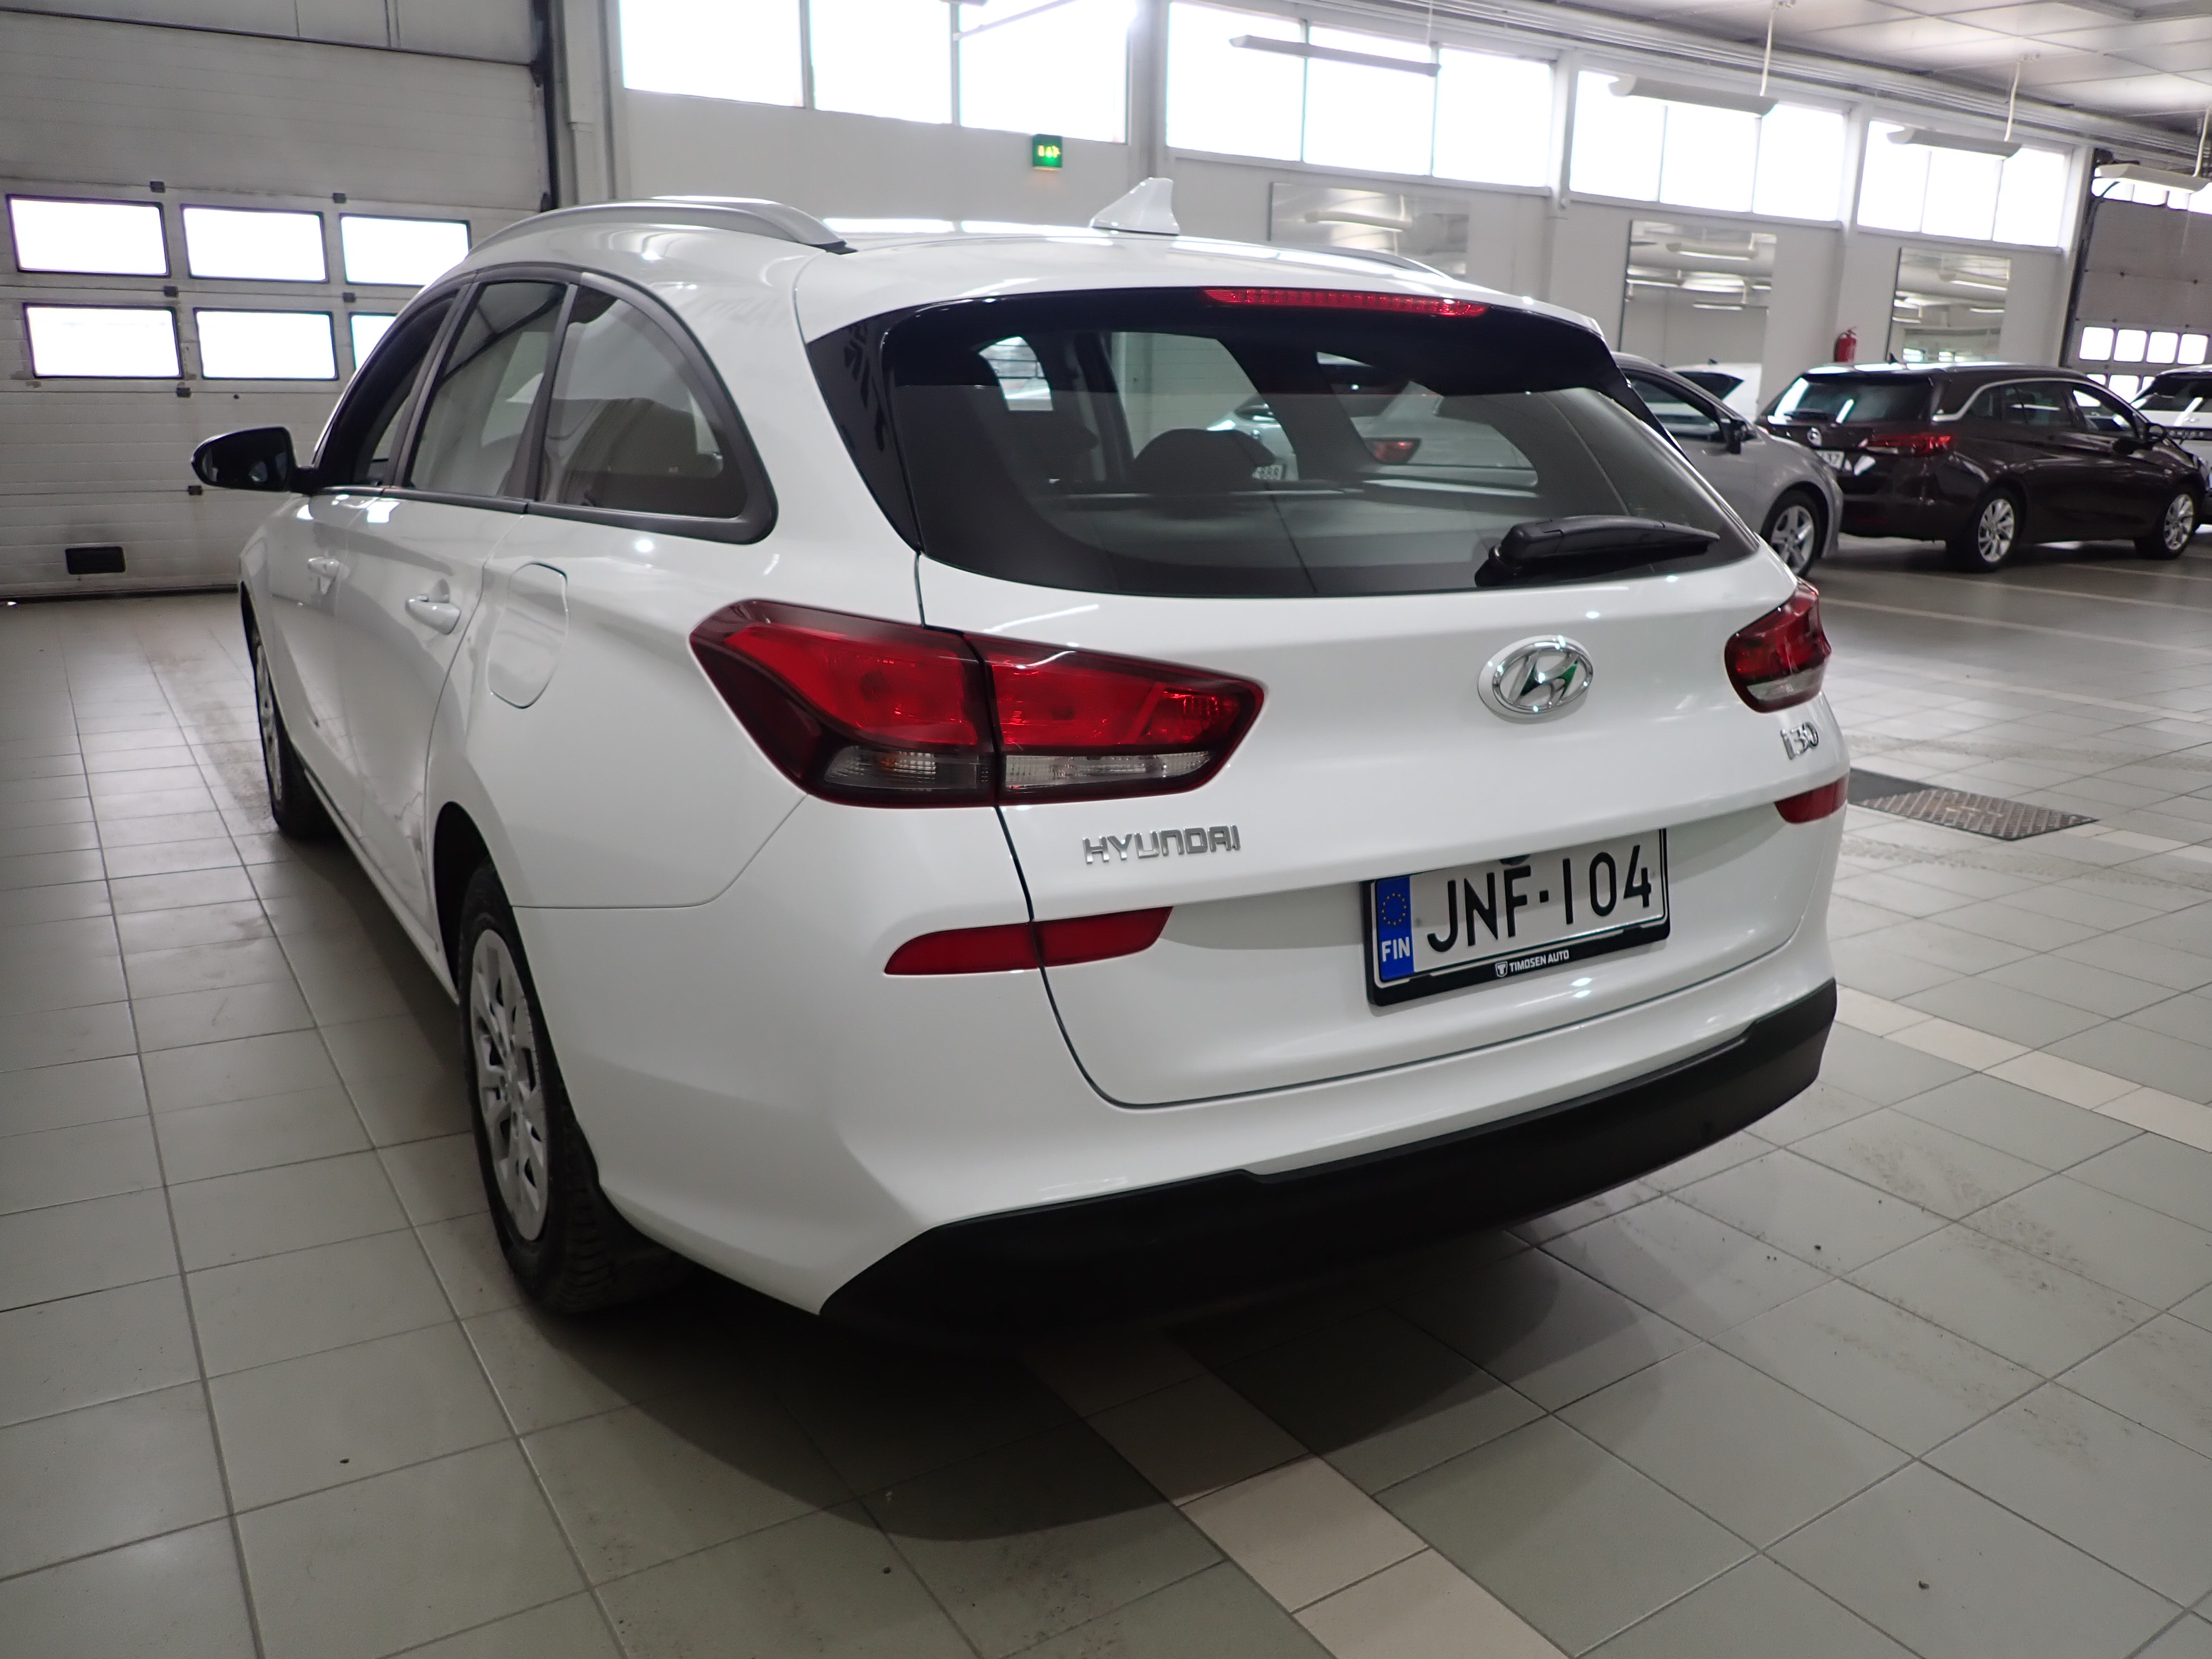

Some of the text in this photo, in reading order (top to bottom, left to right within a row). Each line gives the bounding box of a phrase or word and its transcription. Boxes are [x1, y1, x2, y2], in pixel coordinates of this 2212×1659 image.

[1083, 825, 1241, 864] HYUNDAI
[1427, 844, 1652, 952] JNF-104
[1381, 936, 1411, 962] FIN
[1509, 954, 1547, 973] TIMOSEN
[1547, 950, 1569, 964] AUTO
